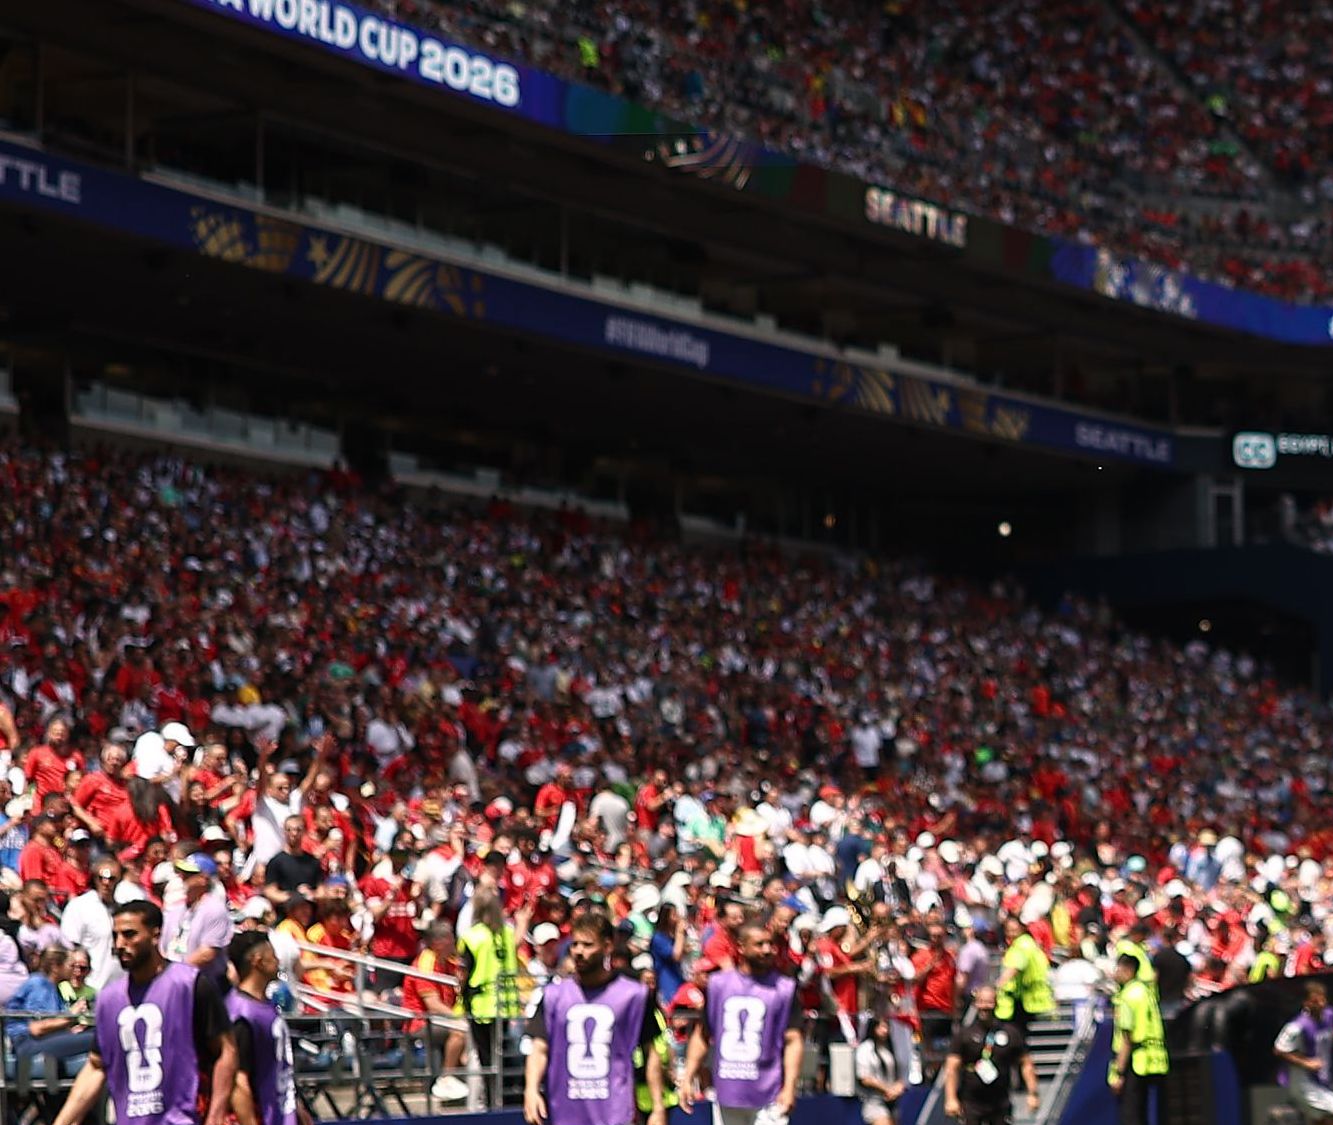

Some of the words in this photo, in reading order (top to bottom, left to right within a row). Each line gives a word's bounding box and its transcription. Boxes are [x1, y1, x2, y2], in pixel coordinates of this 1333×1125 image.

[358, 16, 418, 69] CUP
[418, 39, 521, 107] 2026
[865, 186, 968, 248] SEATTLE
[1074, 421, 1171, 462] SEATTLE
